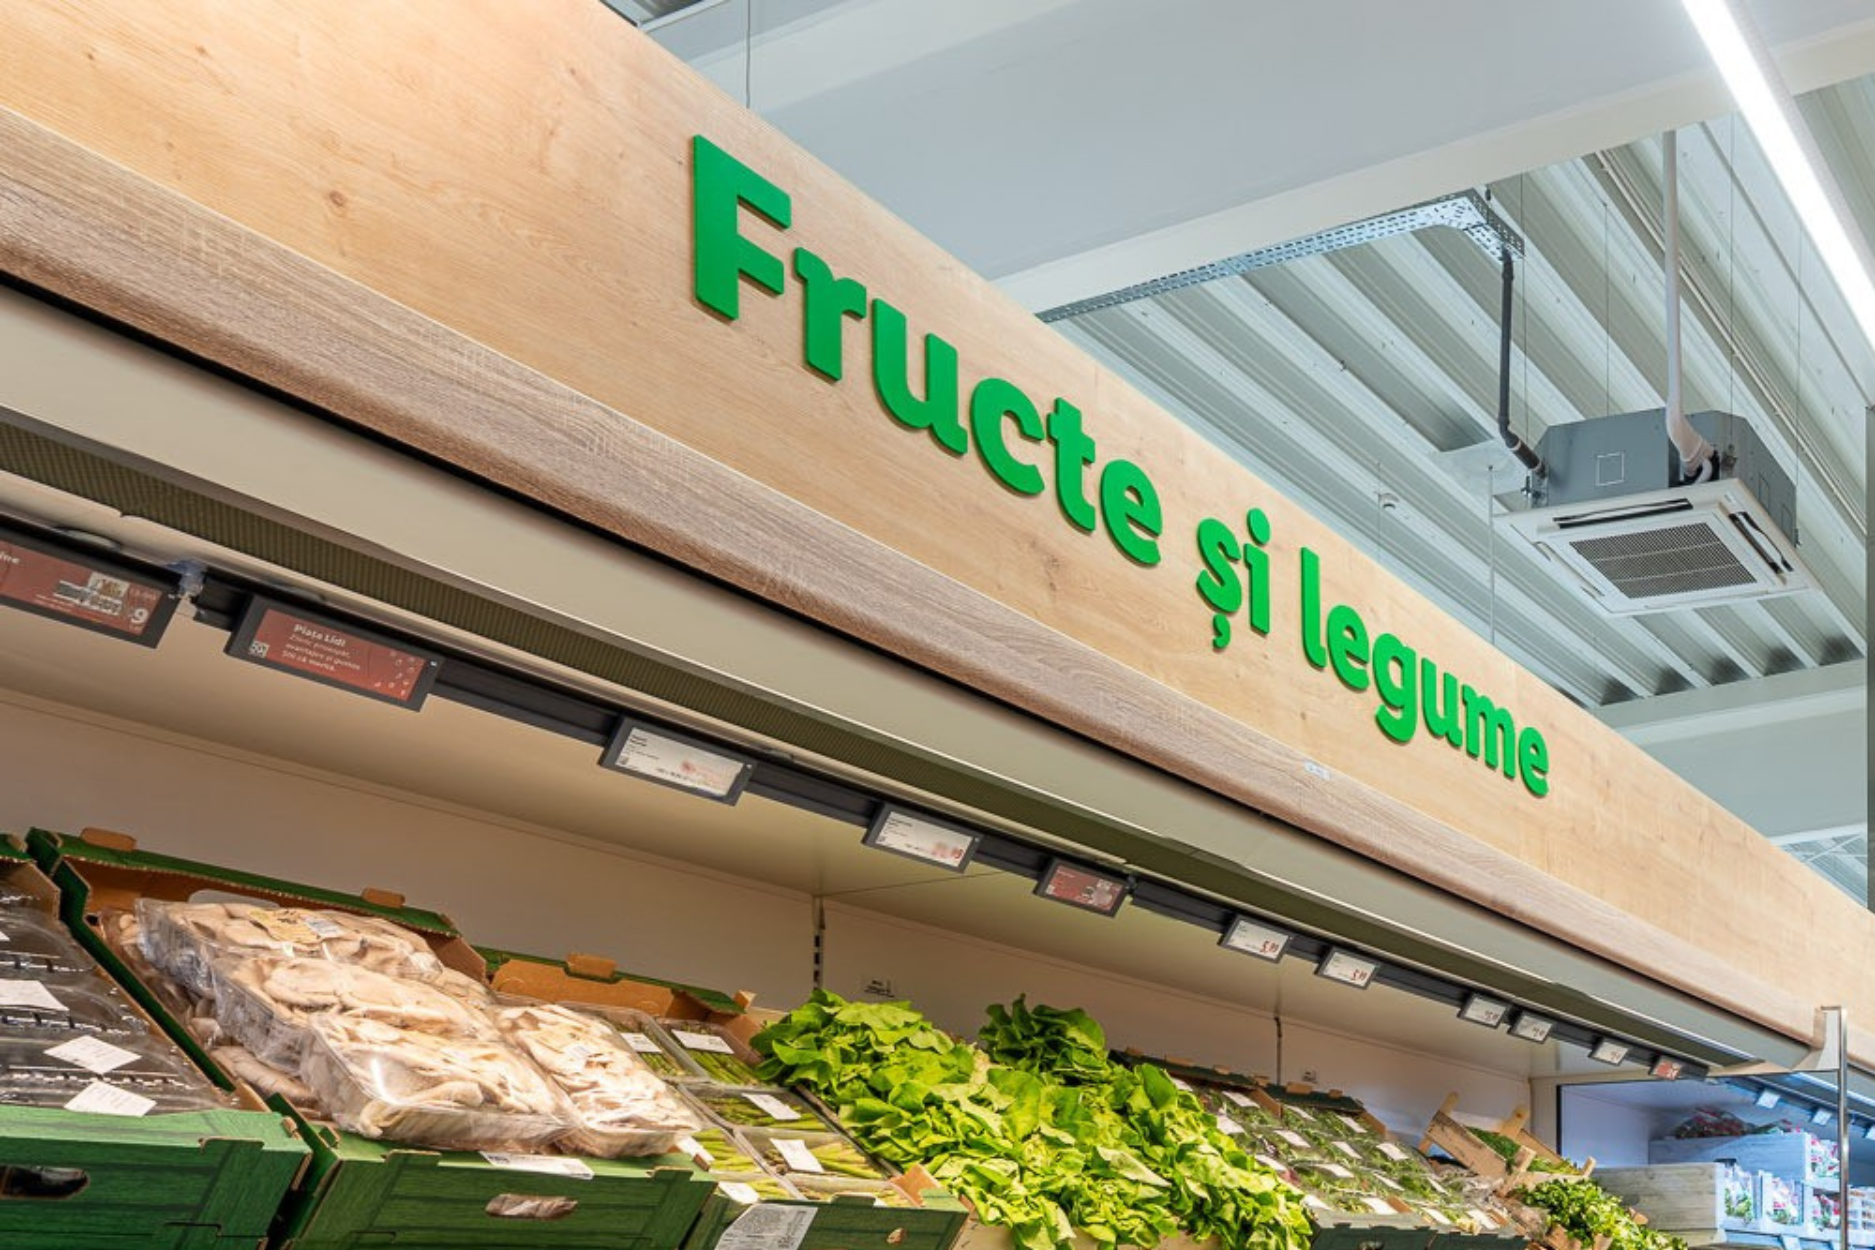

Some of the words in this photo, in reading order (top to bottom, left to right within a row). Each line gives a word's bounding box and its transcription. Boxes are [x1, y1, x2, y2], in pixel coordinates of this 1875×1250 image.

[693, 134, 1163, 567] Fructe
[1197, 508, 1271, 650] și
[1301, 547, 1550, 796] legume
